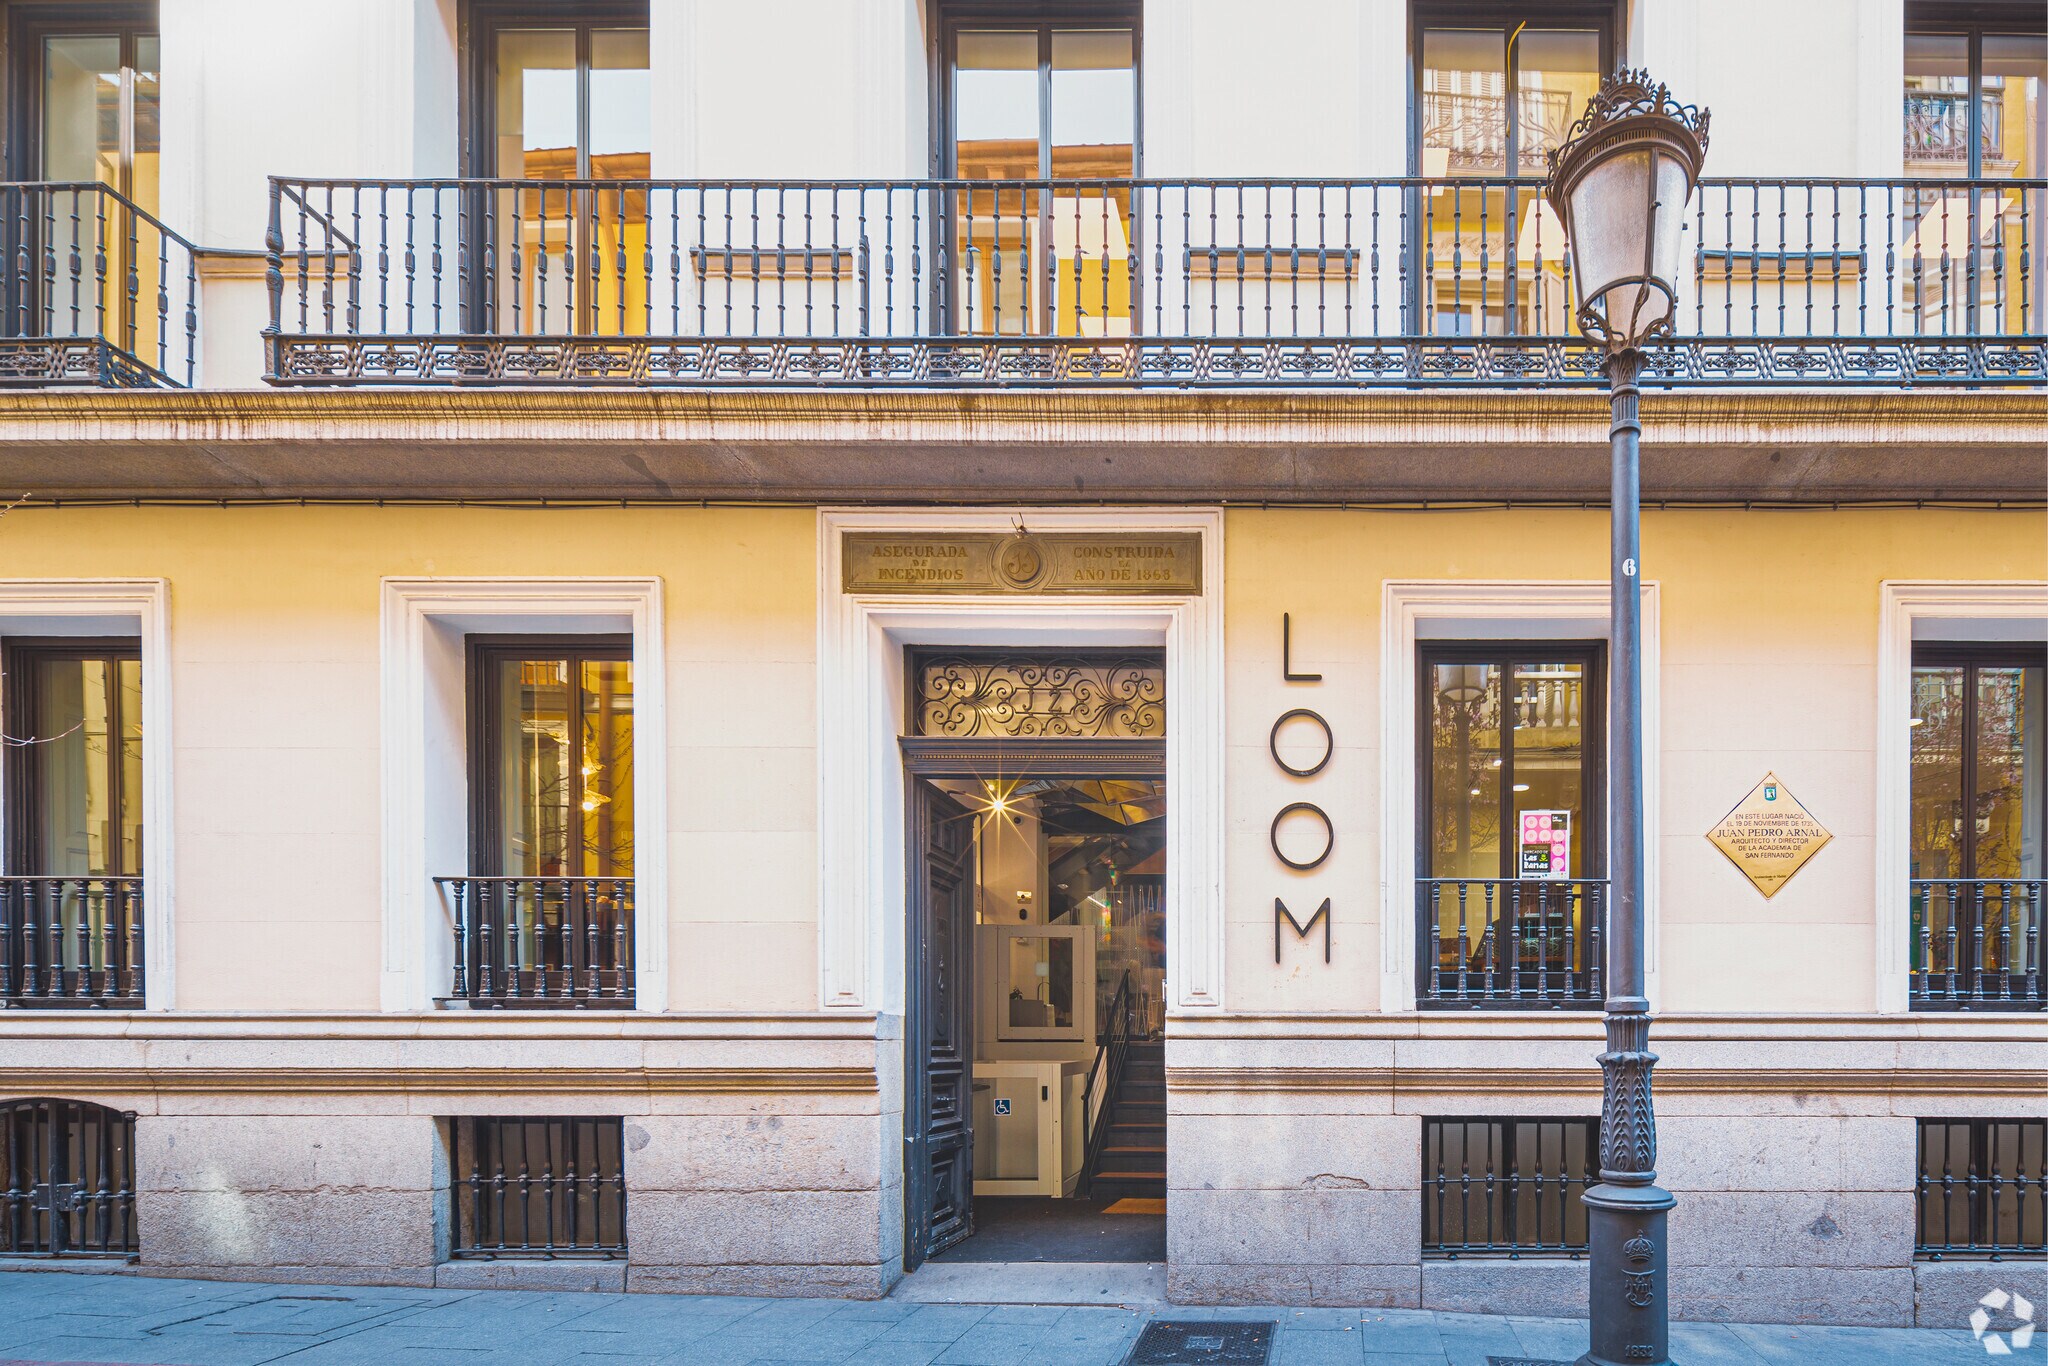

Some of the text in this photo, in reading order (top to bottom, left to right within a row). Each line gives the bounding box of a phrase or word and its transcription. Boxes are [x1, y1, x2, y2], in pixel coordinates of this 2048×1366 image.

[872, 545, 968, 558] ASEGURADA
[1073, 546, 1175, 559] CONSTRUIDA
[912, 559, 928, 567] DE
[1622, 558, 1637, 577] 6
[878, 568, 964, 580] INCENDIOS
[1074, 566, 1105, 580] AÑO
[1110, 569, 1131, 580] DE
[1269, 612, 1334, 964] LOOM
[1717, 828, 1822, 838] JUAN PEDRO ARNAL
